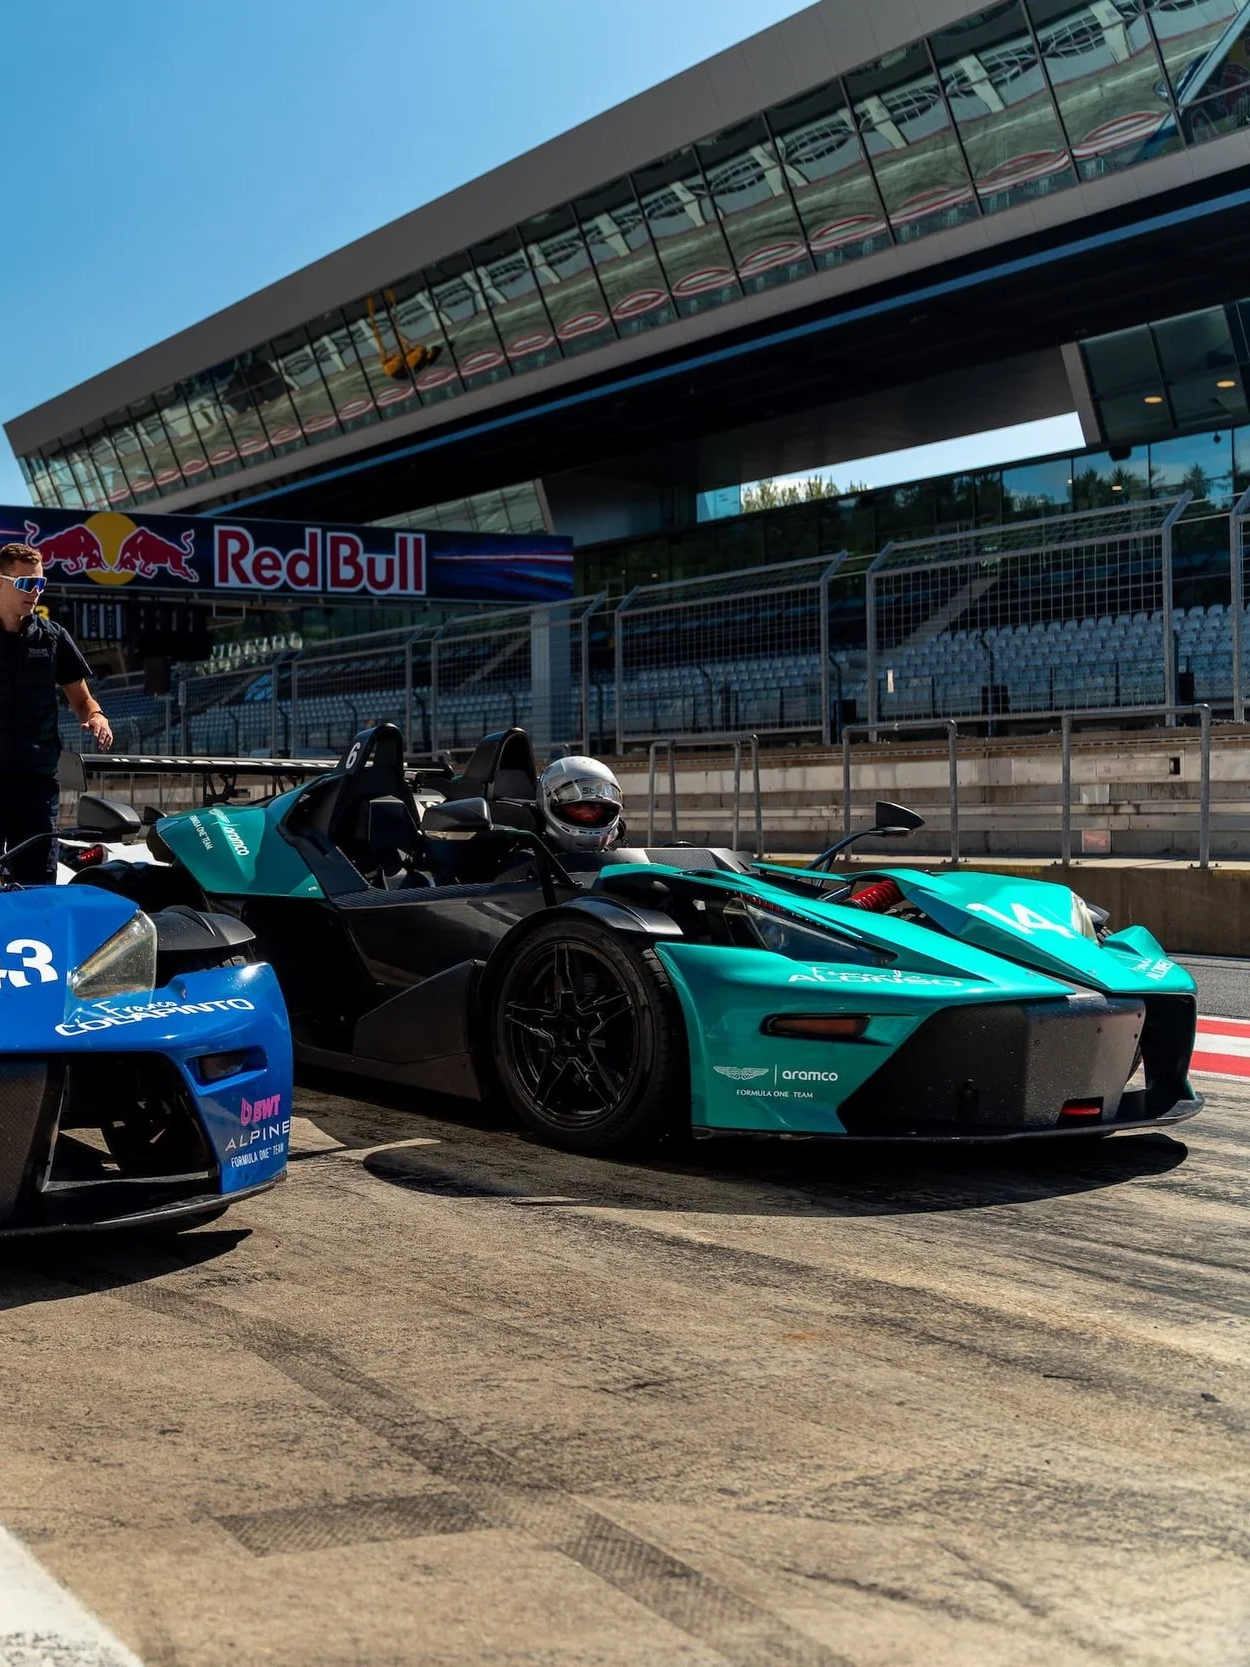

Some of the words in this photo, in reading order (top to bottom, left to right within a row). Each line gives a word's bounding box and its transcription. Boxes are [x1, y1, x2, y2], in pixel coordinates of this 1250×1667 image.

[214, 525, 321, 591] Red
[327, 532, 427, 595] Bull
[965, 903, 1077, 940] 14
[789, 974, 963, 987] ALONSO
[54, 998, 255, 1037] COLAPINTO
[92, 1000, 178, 1018] Franco
[782, 1070, 839, 1081] aramco
[736, 1089, 772, 1098] FORMULA
[773, 1090, 789, 1098] ONE
[793, 1091, 813, 1099] TEAM
[253, 1094, 281, 1124] BWT
[225, 1120, 290, 1152] ALPINE
[230, 1151, 259, 1169] FORMULA
[272, 1142, 284, 1156] TEAM
